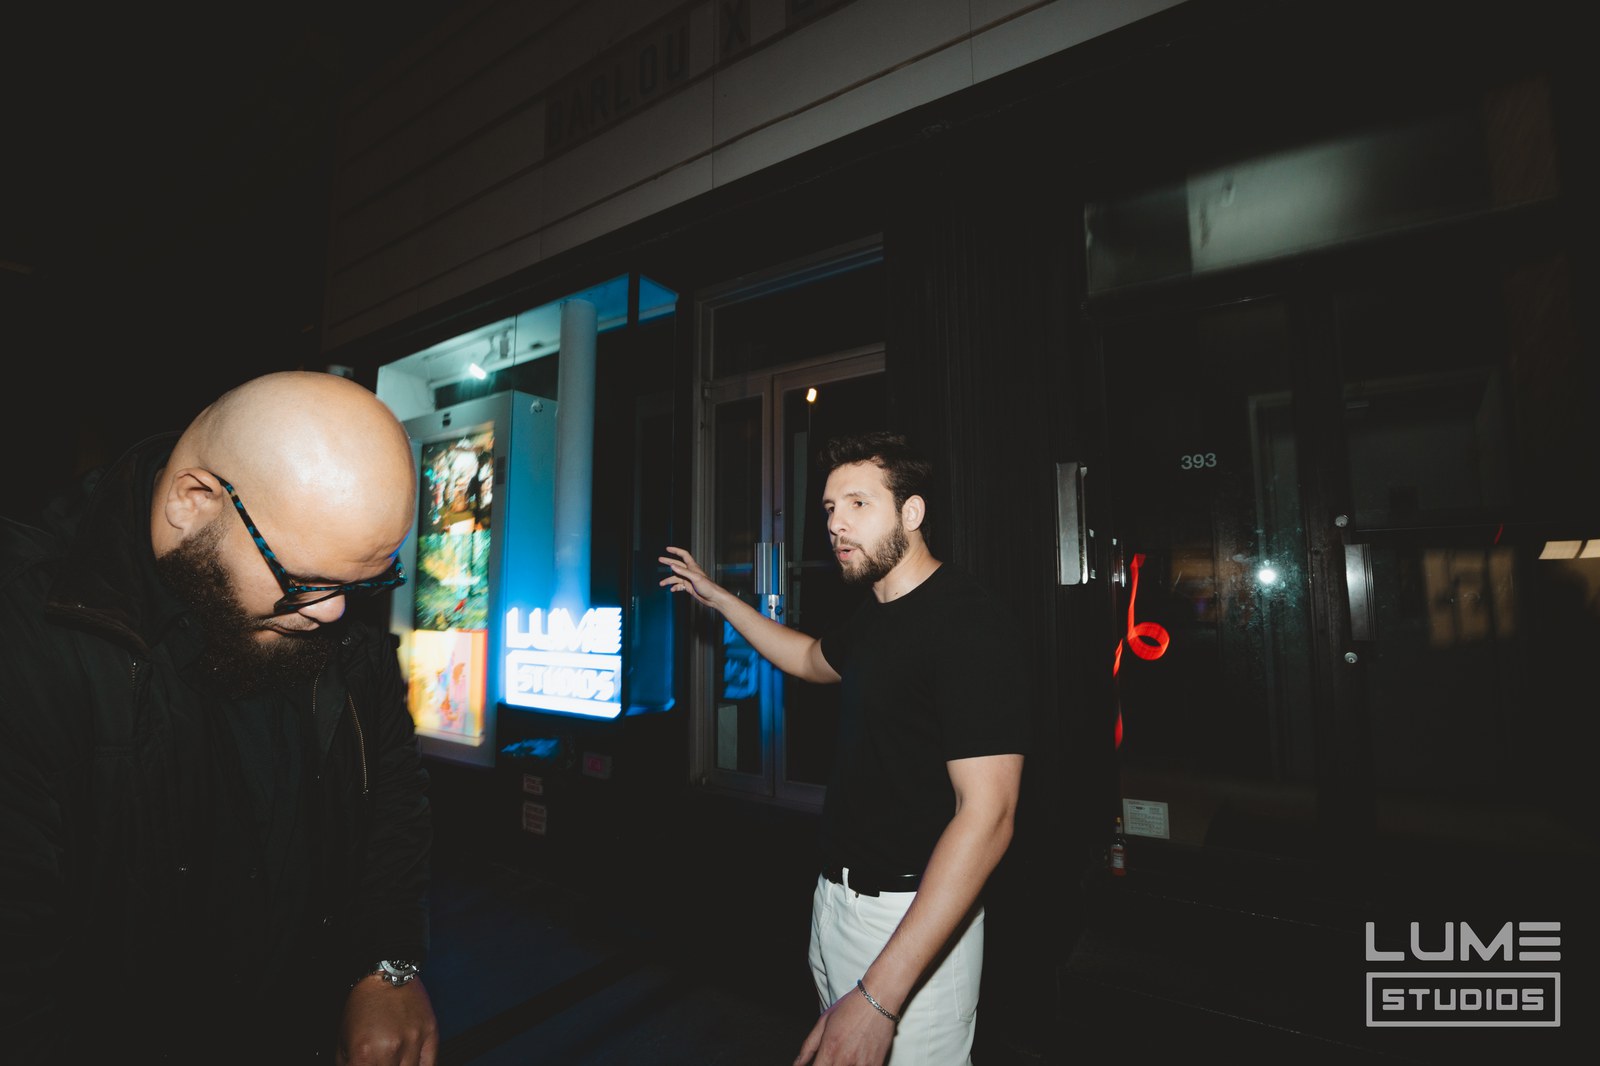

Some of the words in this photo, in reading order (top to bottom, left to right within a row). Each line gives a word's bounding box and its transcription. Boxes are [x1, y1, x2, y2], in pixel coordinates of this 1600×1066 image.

[547, 24, 686, 148] BARLOU
[1181, 452, 1217, 470] 393
[506, 607, 622, 653] LUME
